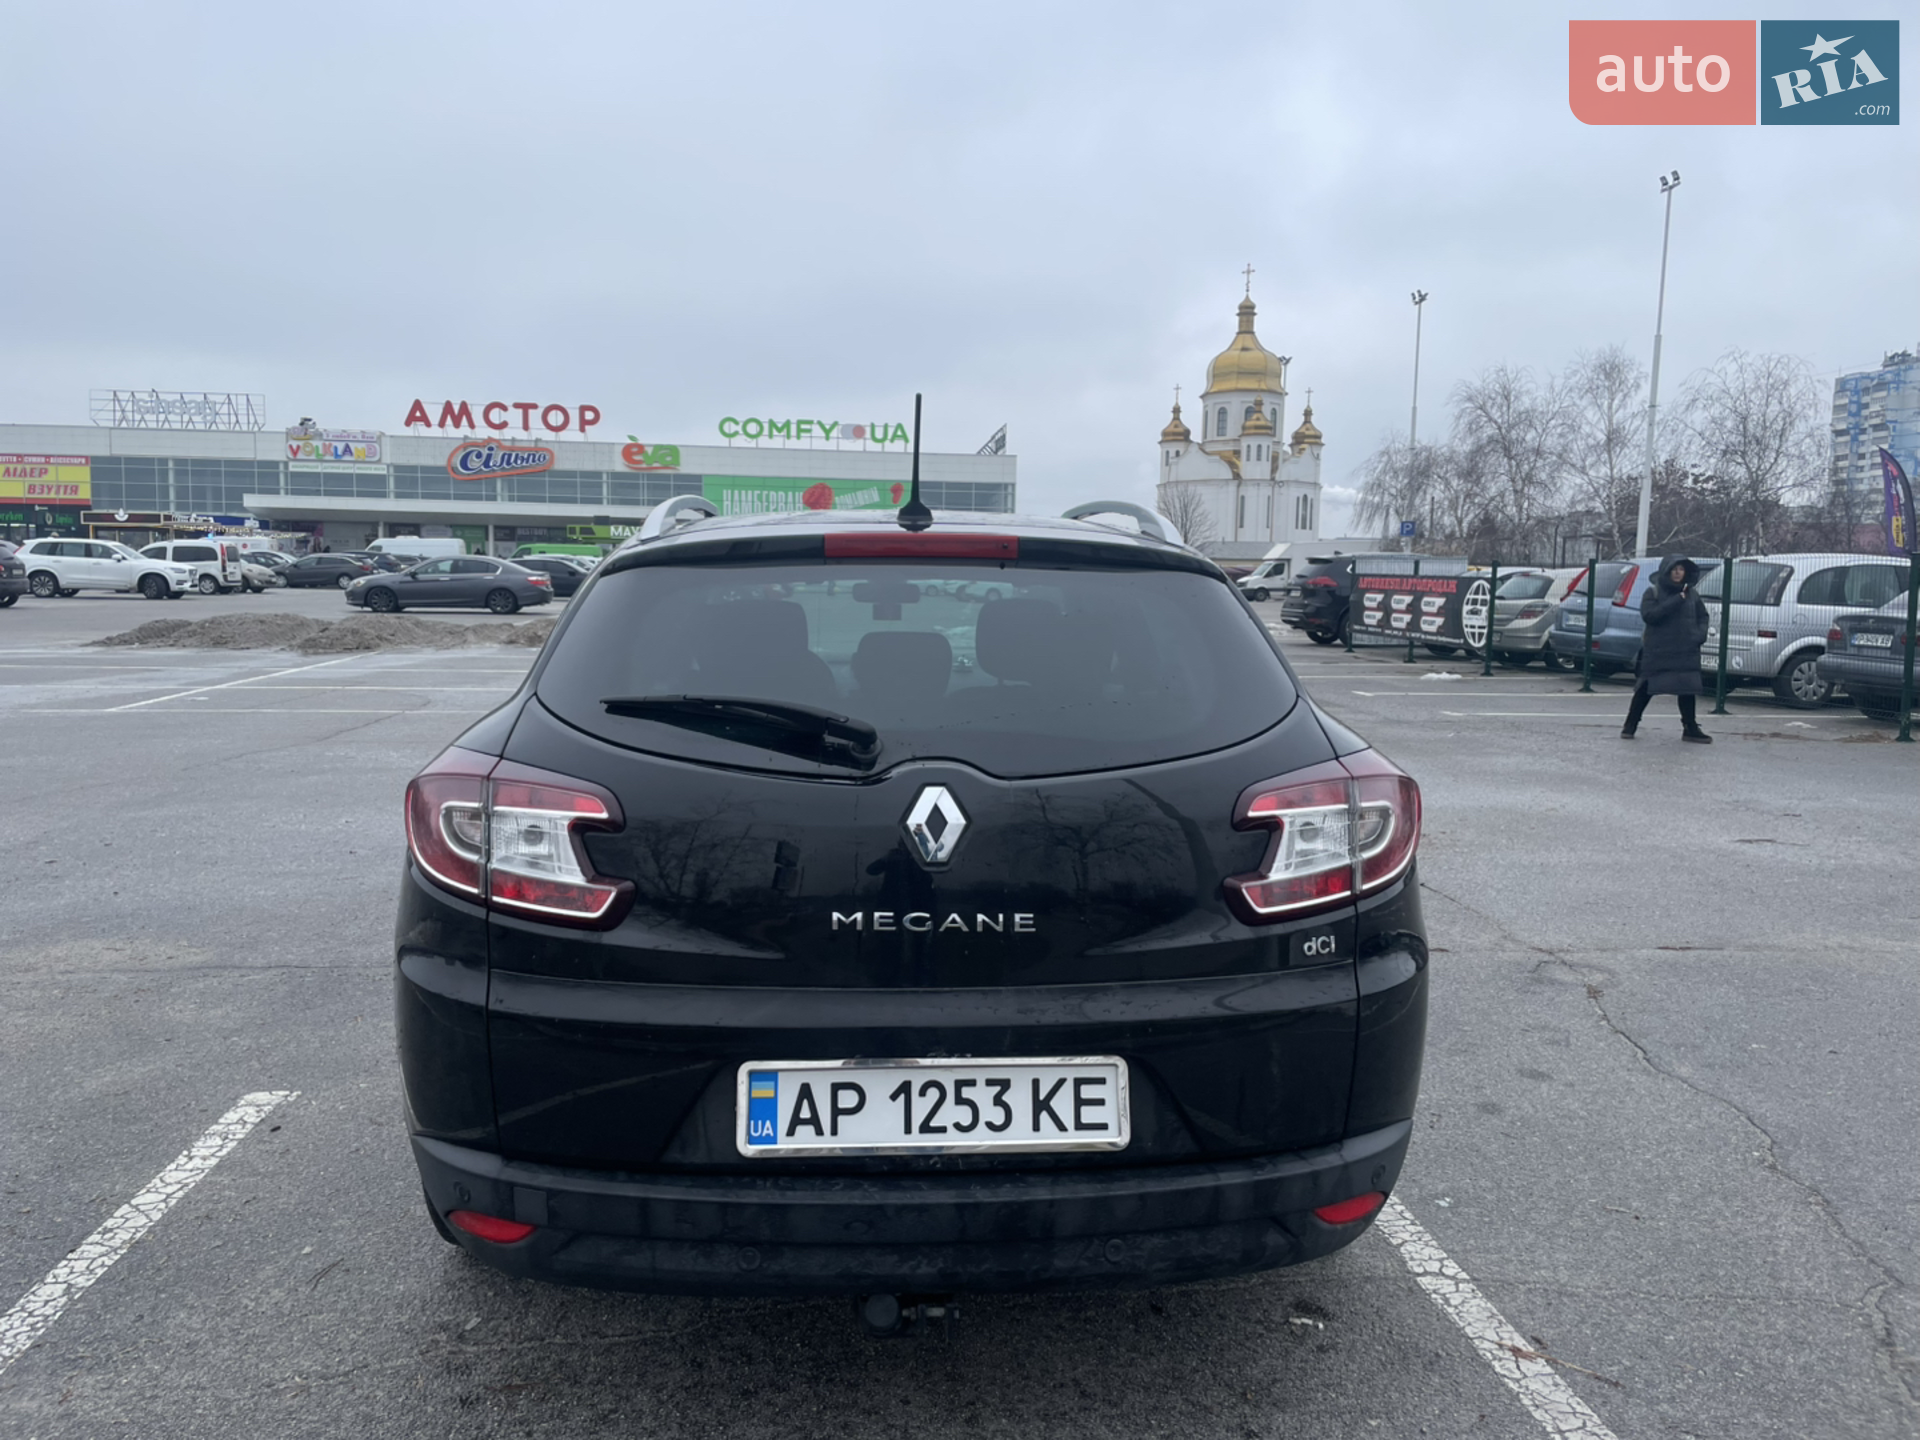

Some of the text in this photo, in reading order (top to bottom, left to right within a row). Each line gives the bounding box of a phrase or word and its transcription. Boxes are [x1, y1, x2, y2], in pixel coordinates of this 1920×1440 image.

[404, 398, 601, 433] АМСТОР
[718, 416, 910, 444] COMFY UA
[288, 441, 377, 461] VOLKLAND
[459, 445, 548, 473] Сільпо
[621, 443, 681, 468] eva
[2, 466, 49, 478] ЛІДЕР
[27, 484, 80, 496] ВЗУТТЯ
[1403, 522, 1413, 534] P
[831, 911, 1037, 933] MEGANE
[785, 1077, 1109, 1138] AP 1253 KE
[749, 1119, 774, 1138] UA
